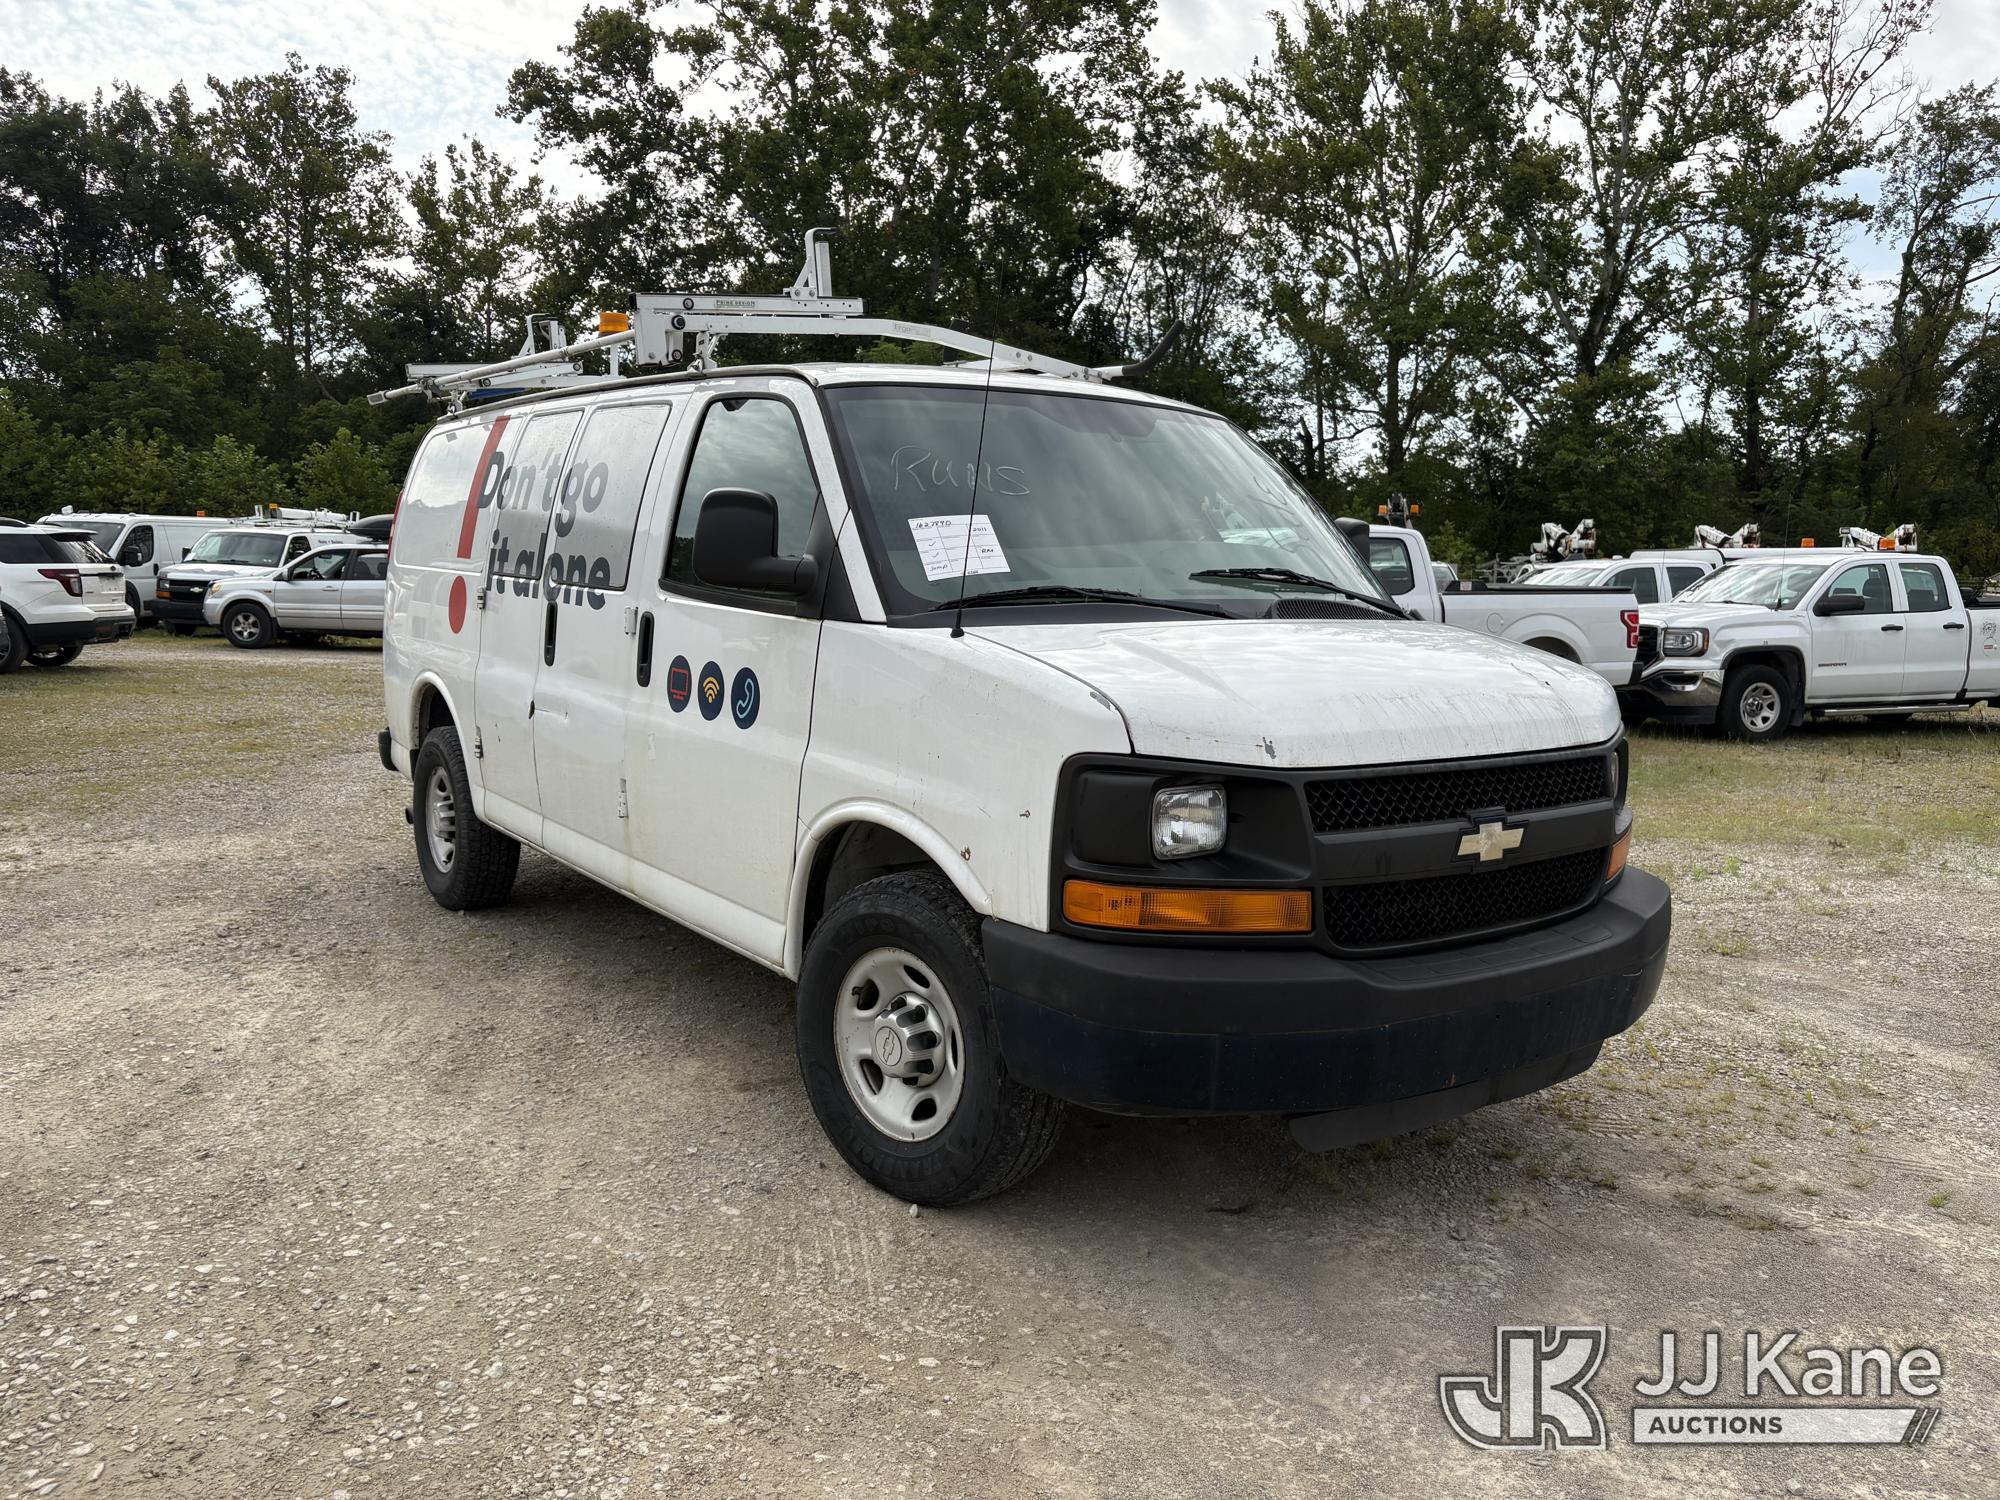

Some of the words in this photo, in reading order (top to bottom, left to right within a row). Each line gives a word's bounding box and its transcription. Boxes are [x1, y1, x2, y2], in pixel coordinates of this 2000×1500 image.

[477, 448, 562, 511] Don't
[554, 459, 609, 538] go
[486, 528, 510, 595] it
[512, 532, 611, 610] alone
